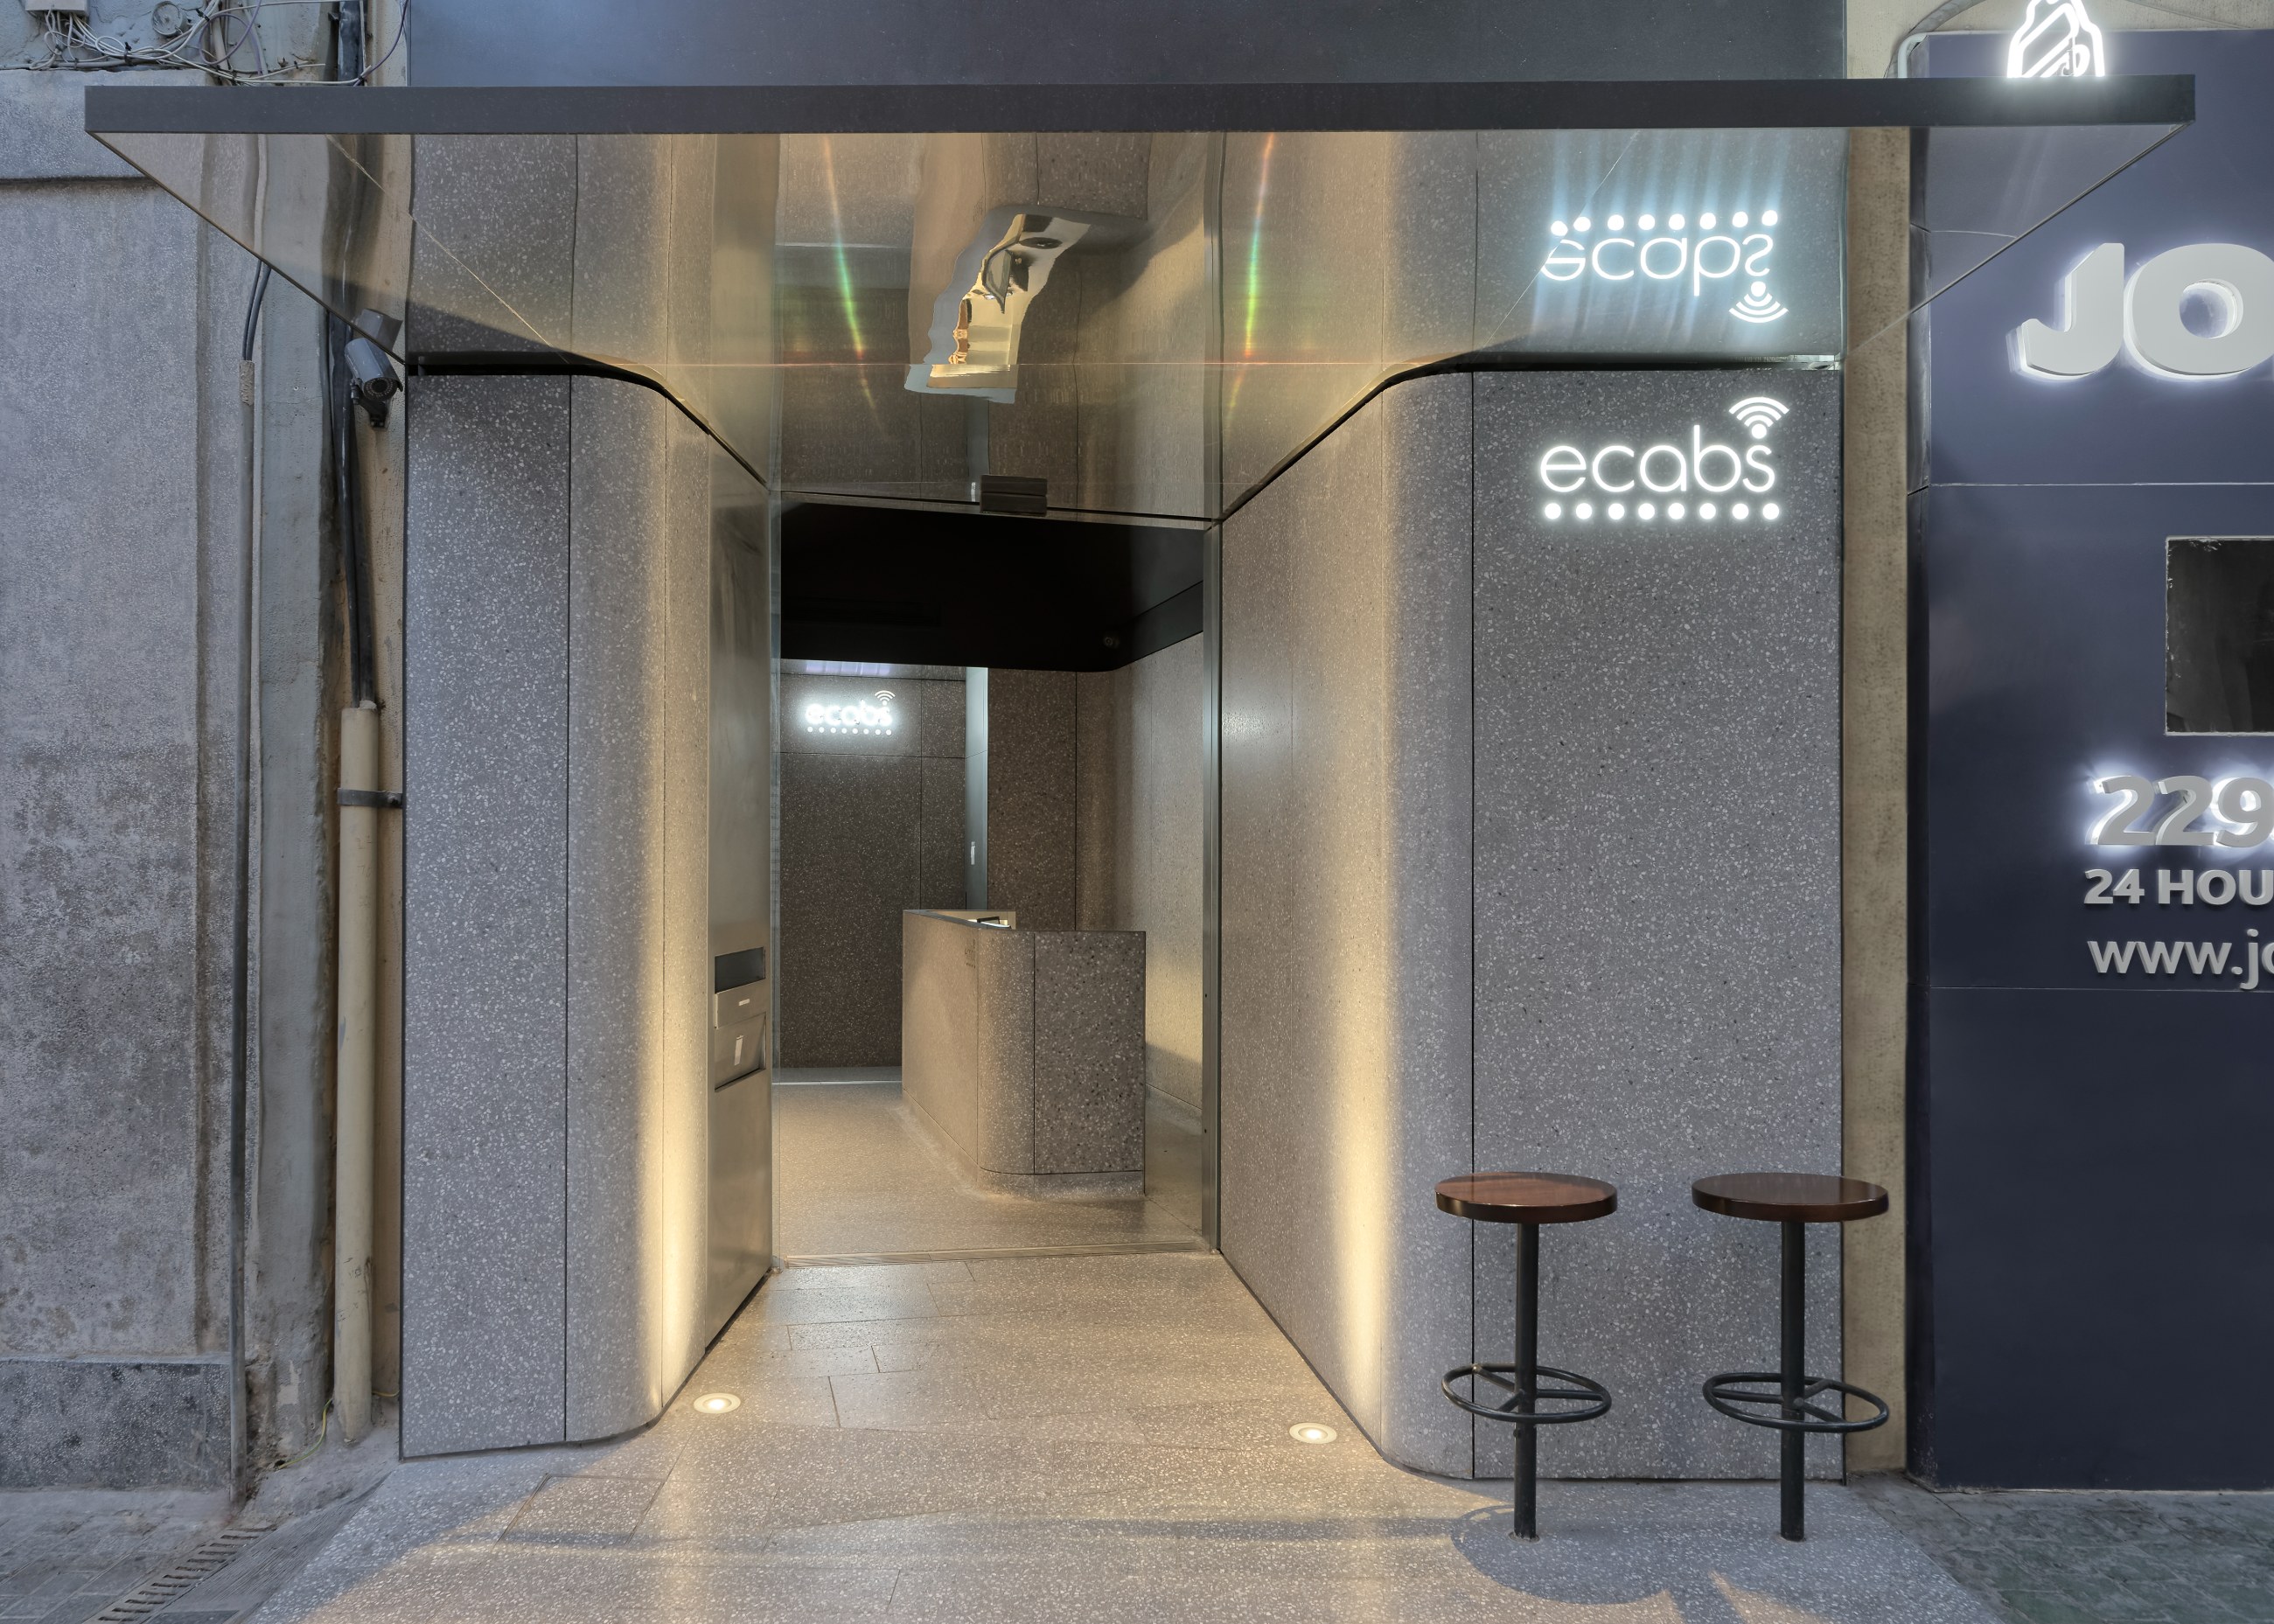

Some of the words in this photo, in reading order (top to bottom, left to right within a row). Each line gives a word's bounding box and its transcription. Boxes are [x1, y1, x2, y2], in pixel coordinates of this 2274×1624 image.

[2009, 241, 2274, 381] JO
[1539, 424, 1775, 493] ecabs
[806, 699, 893, 727] ecabs
[2087, 775, 2274, 847] 229
[2083, 868, 2145, 904] 24
[2158, 869, 2274, 905] HOU
